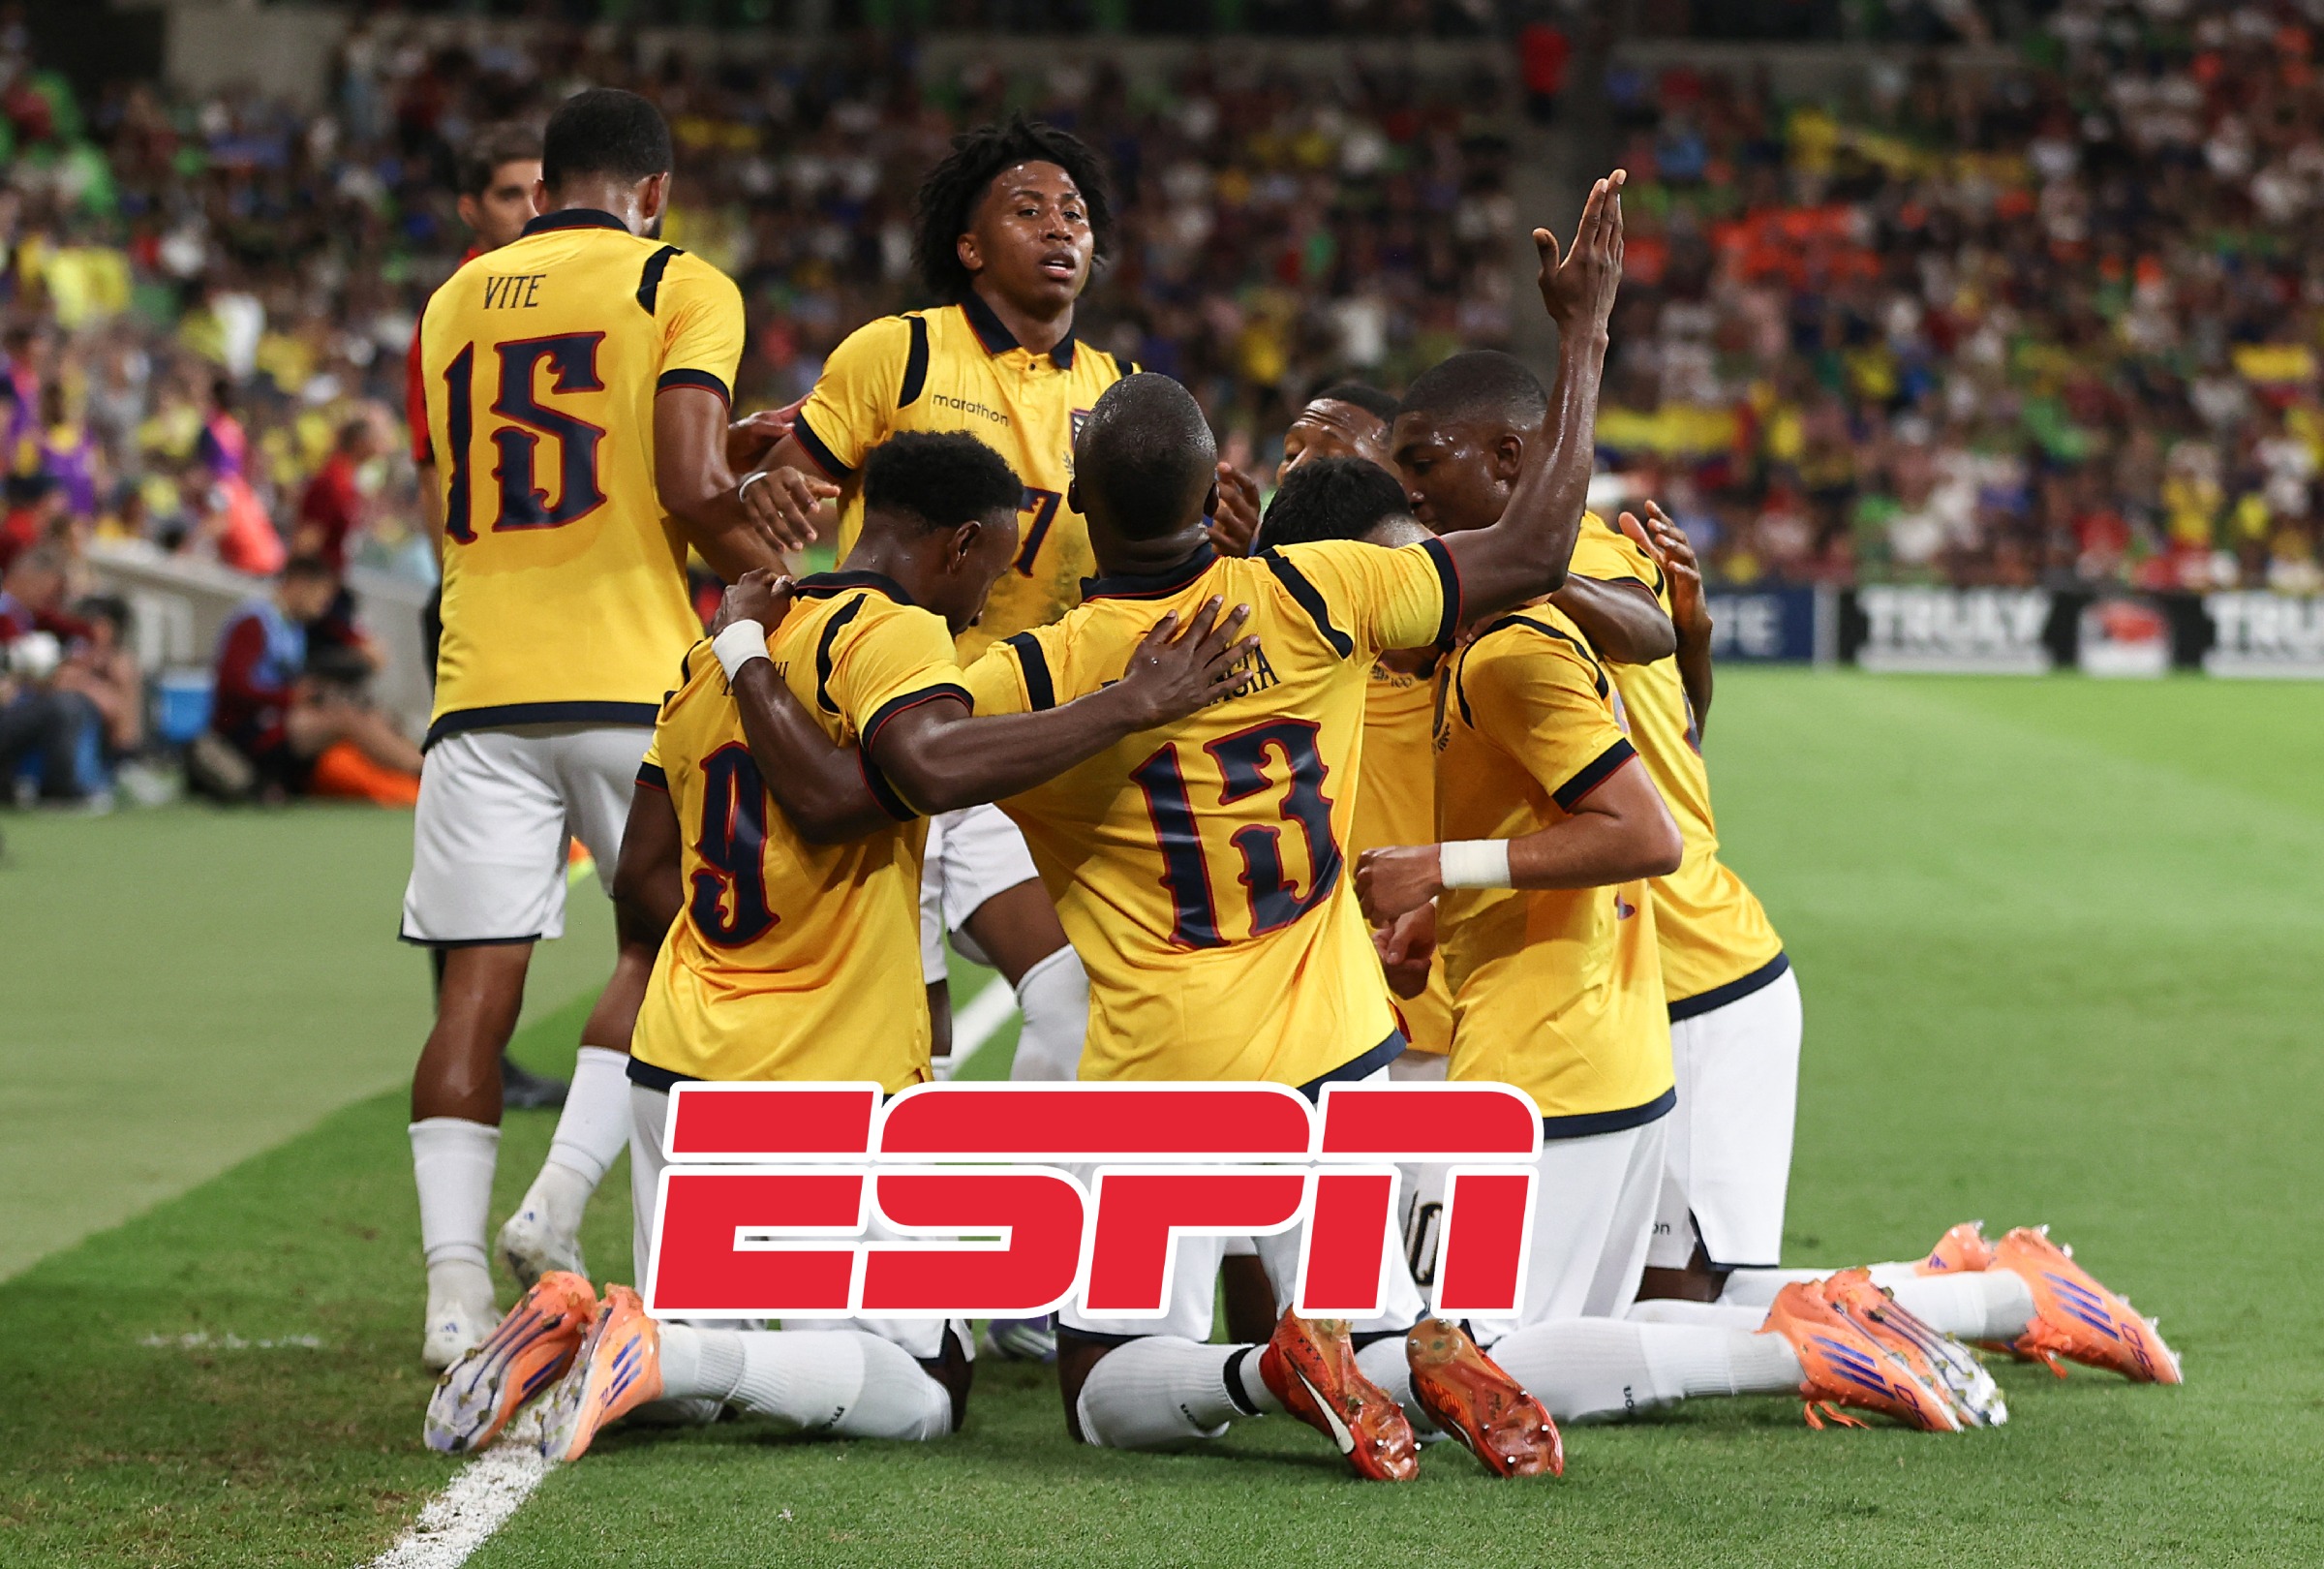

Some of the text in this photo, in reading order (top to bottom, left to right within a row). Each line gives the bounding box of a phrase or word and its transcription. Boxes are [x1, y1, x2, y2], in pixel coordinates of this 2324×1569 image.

[483, 274, 546, 310] VITE
[443, 330, 607, 544] 15
[933, 394, 1009, 427] marathon
[689, 740, 780, 941] 9
[1128, 718, 1344, 950] 13
